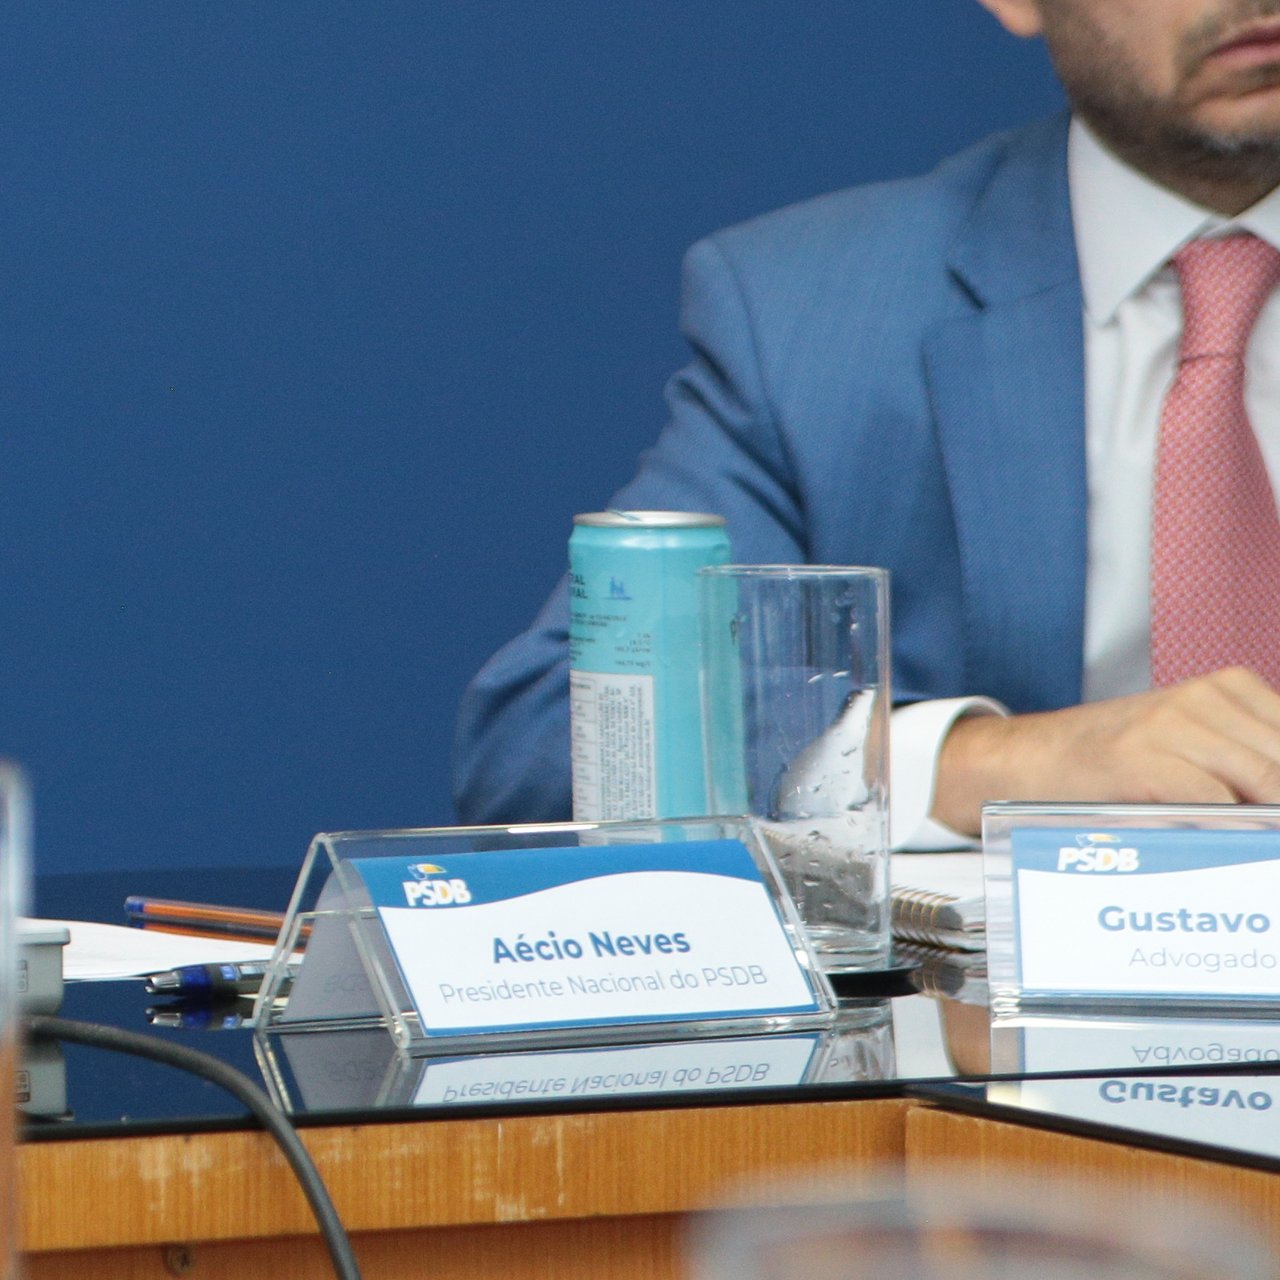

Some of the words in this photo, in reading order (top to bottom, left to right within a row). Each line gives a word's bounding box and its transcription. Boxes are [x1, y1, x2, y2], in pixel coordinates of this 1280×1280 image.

[1057, 847, 1139, 871] PSDB
[402, 879, 471, 907] PSDB
[1098, 906, 1271, 933] Gustavo
[493, 931, 583, 963] Aécio
[589, 931, 691, 957] Neves
[1129, 948, 1277, 973] Advogado
[441, 982, 563, 1003] Presidente
[567, 972, 663, 995] Nacional
[670, 970, 699, 988] do
[702, 964, 767, 987] PSDB
